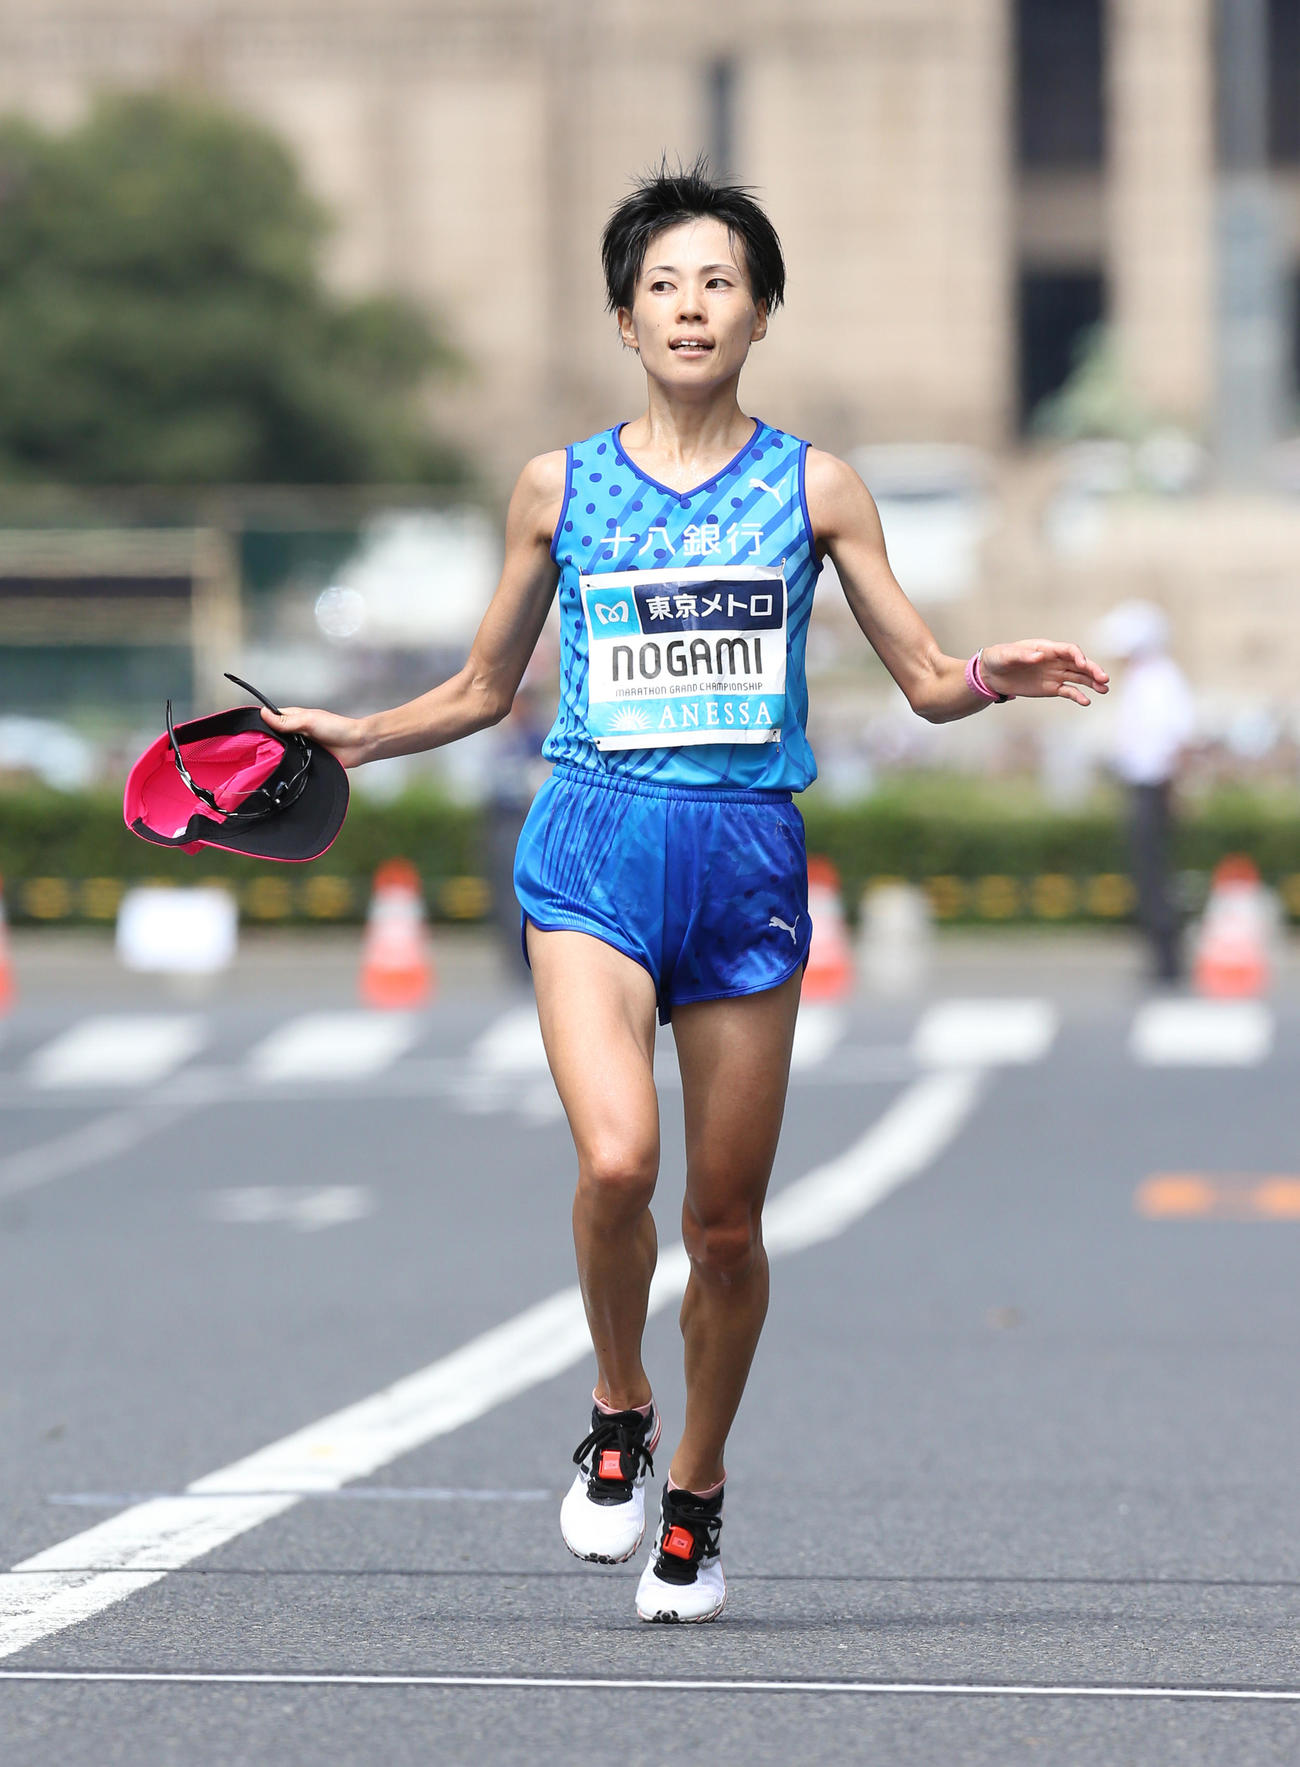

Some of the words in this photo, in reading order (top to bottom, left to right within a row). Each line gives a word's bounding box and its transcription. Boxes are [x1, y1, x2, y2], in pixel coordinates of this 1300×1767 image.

[600, 522, 764, 557] 十八銀行
[645, 593, 774, 620] 東京メトロ
[611, 637, 763, 681] NOGAMI
[615, 686, 667, 697] MARATHON
[669, 683, 698, 693] GRAND
[699, 681, 763, 692] CHAMPIONSHIP
[658, 701, 773, 728] ANESSA
